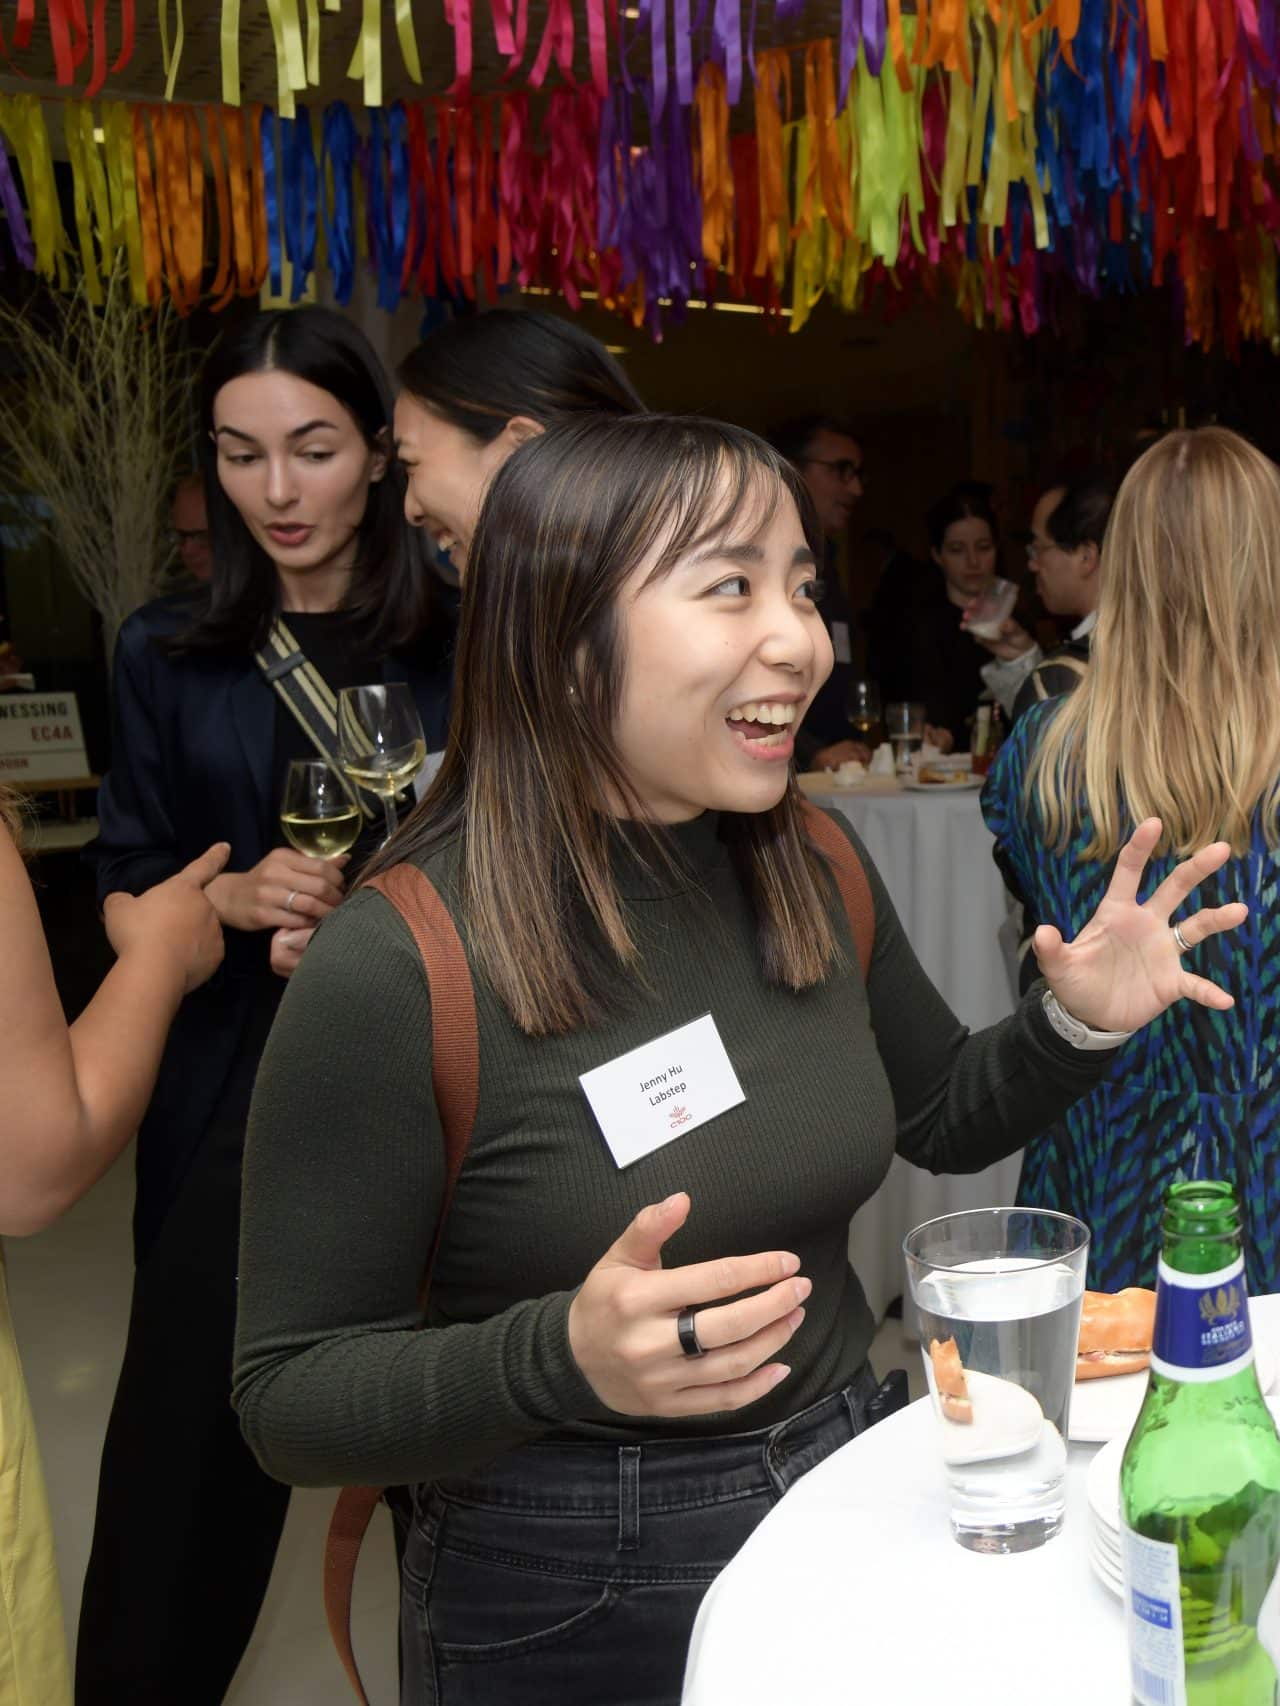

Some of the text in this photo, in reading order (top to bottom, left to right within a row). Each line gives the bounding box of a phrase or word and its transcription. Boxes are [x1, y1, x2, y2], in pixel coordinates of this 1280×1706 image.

[31, 725, 73, 741] EC4A
[639, 1064, 683, 1093] Jenny Hu
[649, 1081, 687, 1106] Labstep
